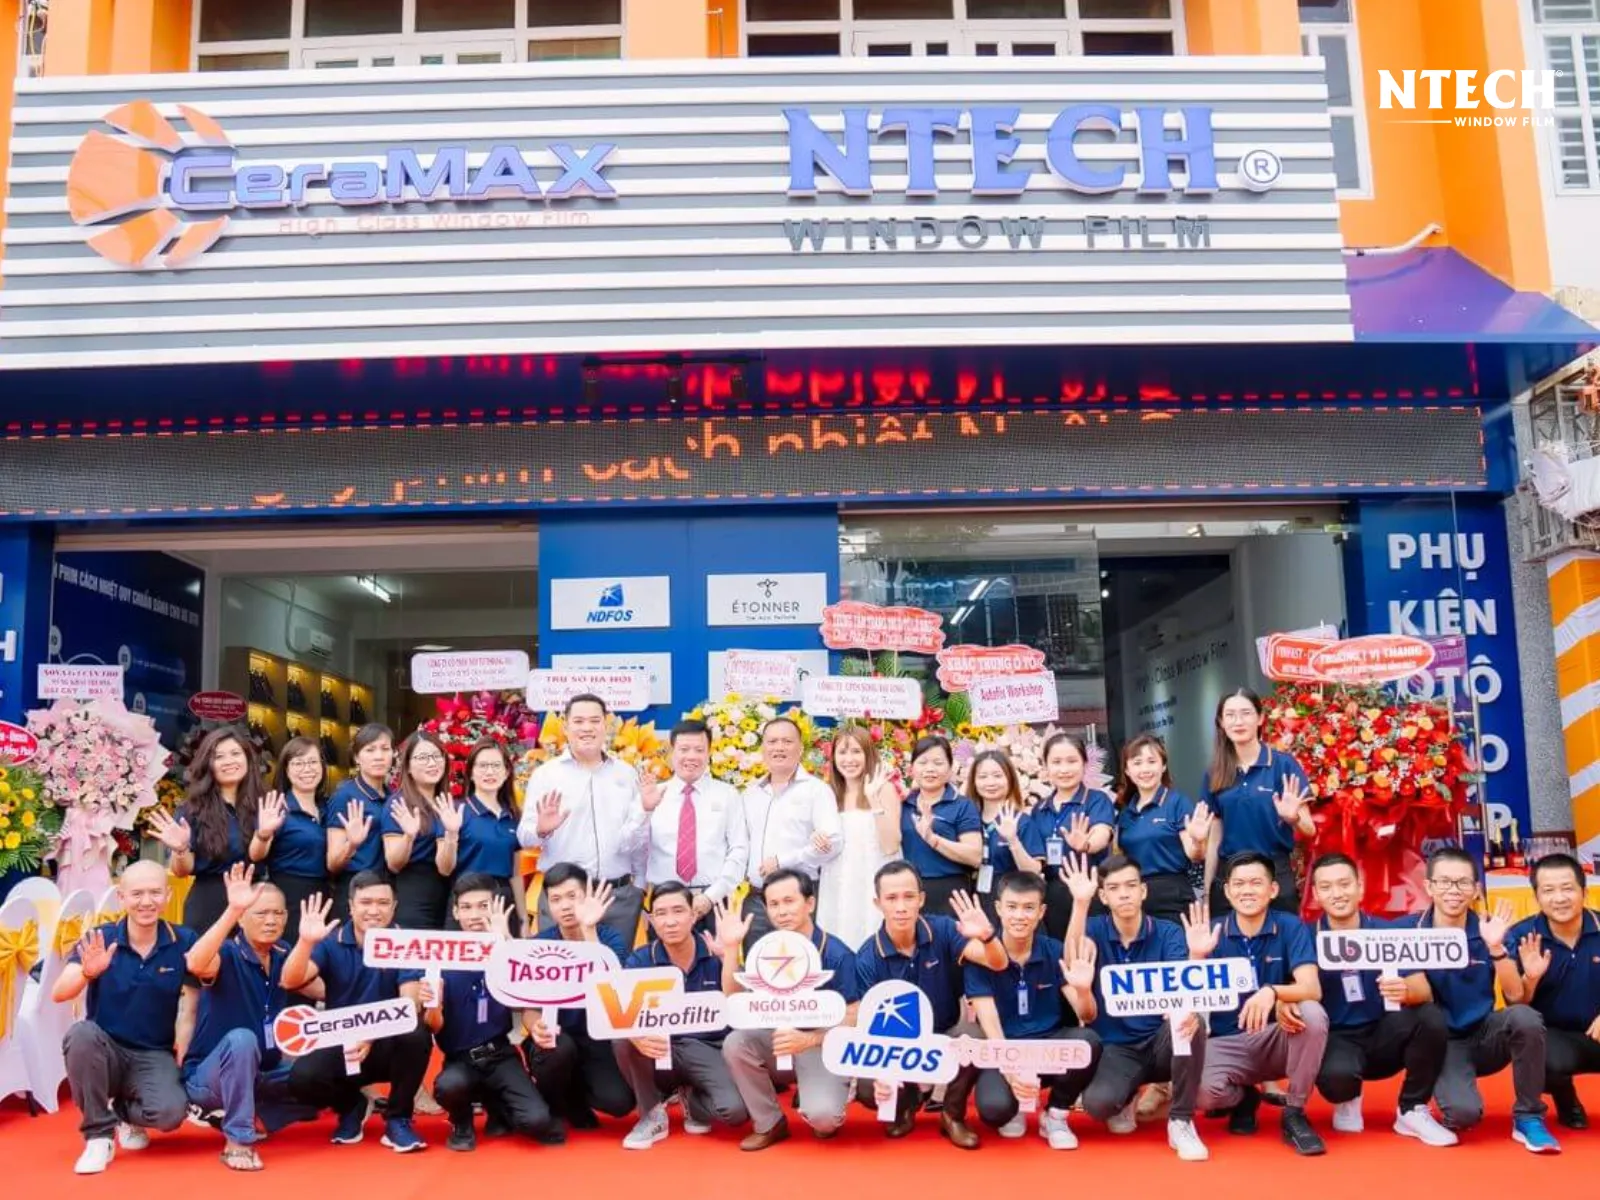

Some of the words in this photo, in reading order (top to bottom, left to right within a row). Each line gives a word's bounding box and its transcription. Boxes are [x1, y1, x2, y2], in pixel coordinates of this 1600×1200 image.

[781, 104, 1219, 197] NTECH
[166, 144, 619, 211] CeraMAX
[783, 215, 1045, 252] WINDOW
[1084, 213, 1211, 250] FILM
[1387, 532, 1486, 581] PHỤ
[586, 609, 633, 623] NDFOS
[732, 599, 800, 614] ÉTONNER
[373, 936, 496, 962] DrARTEX
[1365, 941, 1462, 964] UBAUTO
[1109, 963, 1231, 995] NTECH
[749, 998, 785, 1013] NGÔI
[789, 999, 818, 1011] SAO
[1116, 998, 1184, 1011] WINDOW
[1193, 995, 1231, 1008] FILM
[303, 1005, 410, 1036] CeraMAX
[840, 1042, 943, 1073] NDFOS
